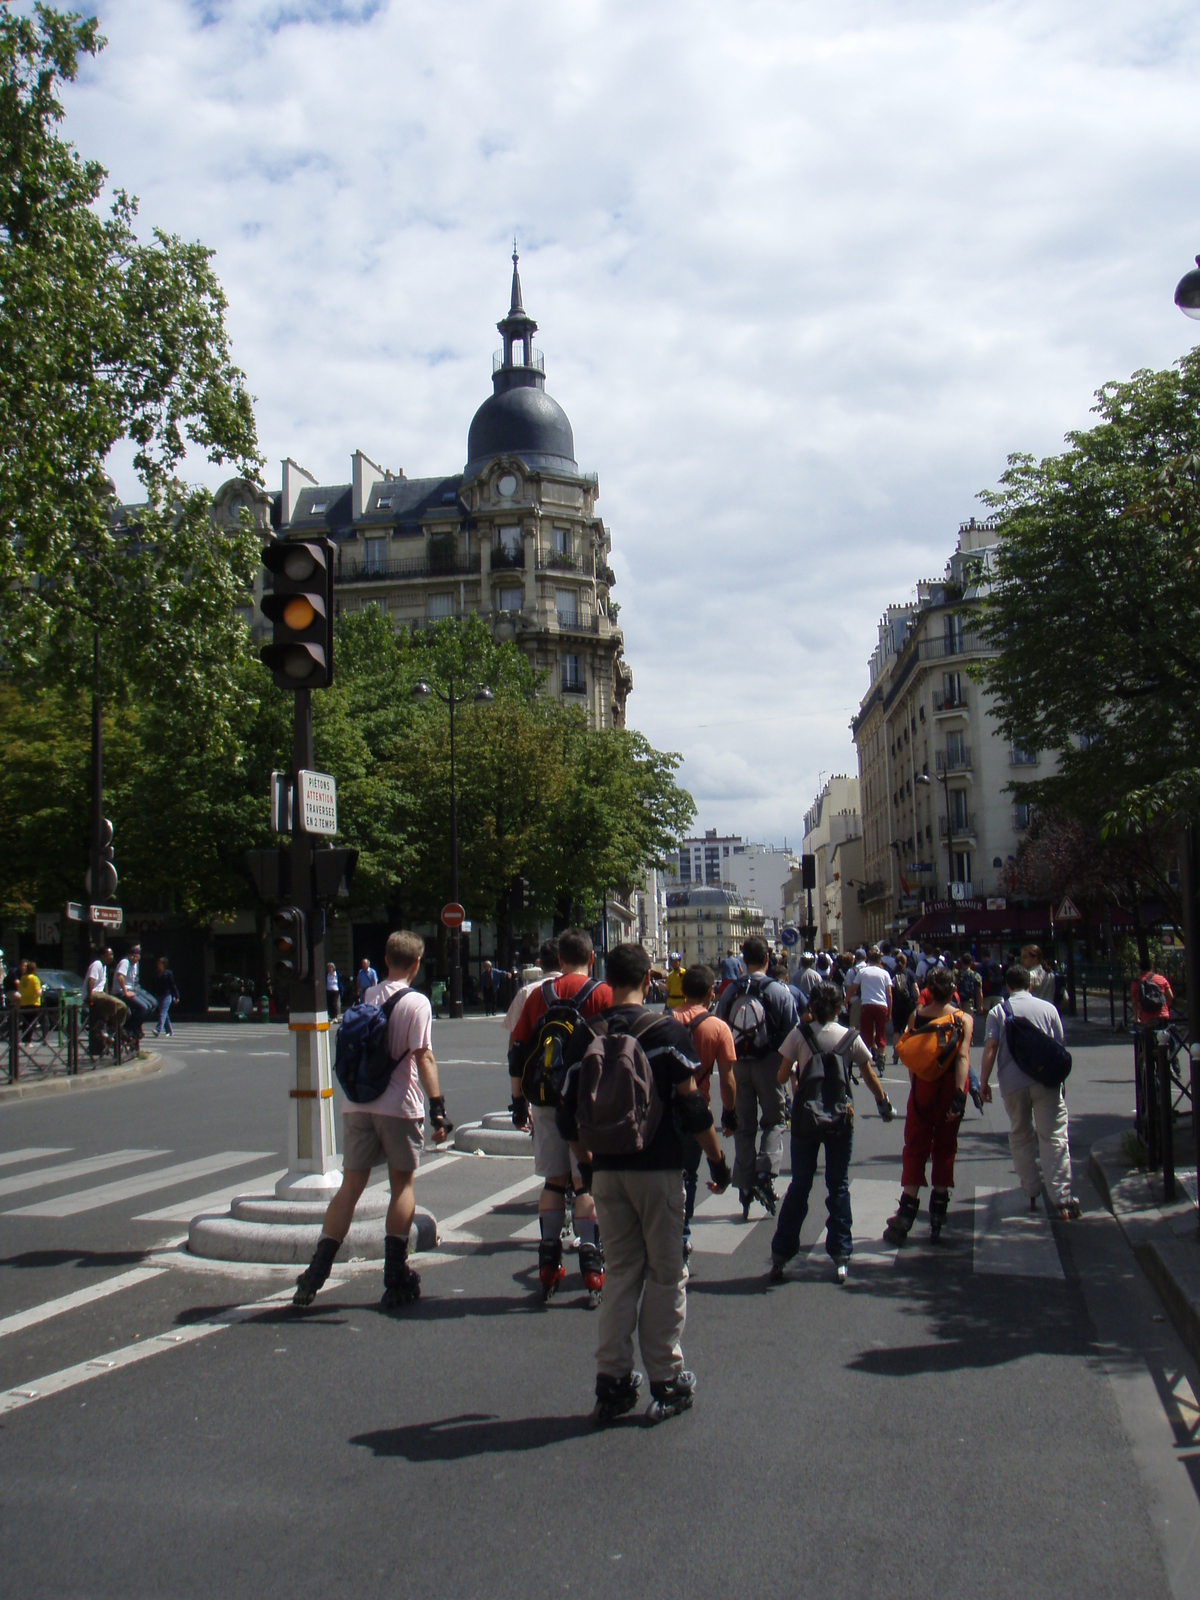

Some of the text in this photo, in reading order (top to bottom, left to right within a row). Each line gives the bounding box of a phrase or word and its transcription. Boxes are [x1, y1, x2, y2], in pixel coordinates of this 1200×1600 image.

[308, 777, 330, 790] PIÉTONS
[307, 790, 333, 804] ATTENTION
[306, 803, 334, 817] TRAVERSEZ
[306, 816, 335, 830] EN 2 TEMPS
[925, 901, 982, 914] LE DUGMMIER
